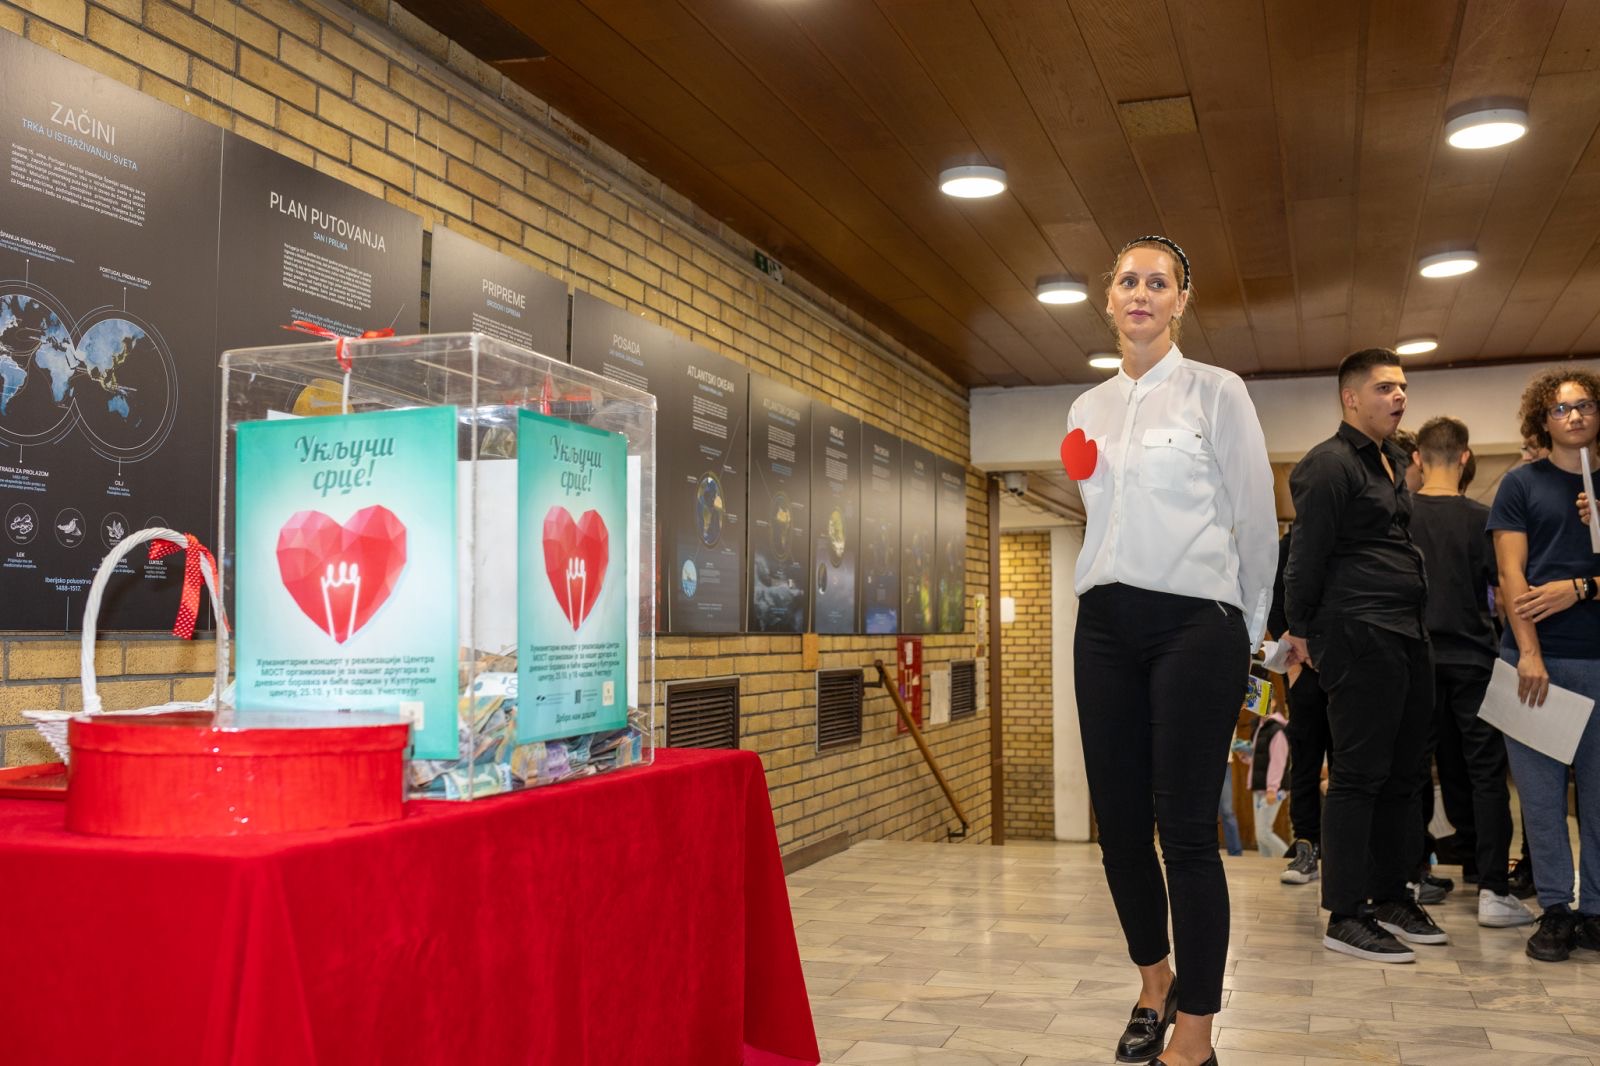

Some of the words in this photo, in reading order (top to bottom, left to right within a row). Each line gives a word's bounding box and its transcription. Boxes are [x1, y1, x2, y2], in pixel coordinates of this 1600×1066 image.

[50, 102, 115, 146] ZAČINI
[22, 118, 44, 135] TRKA
[46, 128, 53, 138] U
[54, 131, 112, 161] ISTRAŽIVANJU
[114, 154, 138, 171] SVETA
[270, 192, 307, 222] PLAN
[311, 208, 386, 252] PUTOVANJA
[313, 232, 325, 243] SAN
[482, 279, 526, 309] PRIPREME
[613, 334, 640, 356] POSADA
[294, 435, 394, 468] Укључи
[550, 435, 602, 473] Укључи
[313, 459, 375, 498] срце!
[560, 469, 592, 496] срце!
